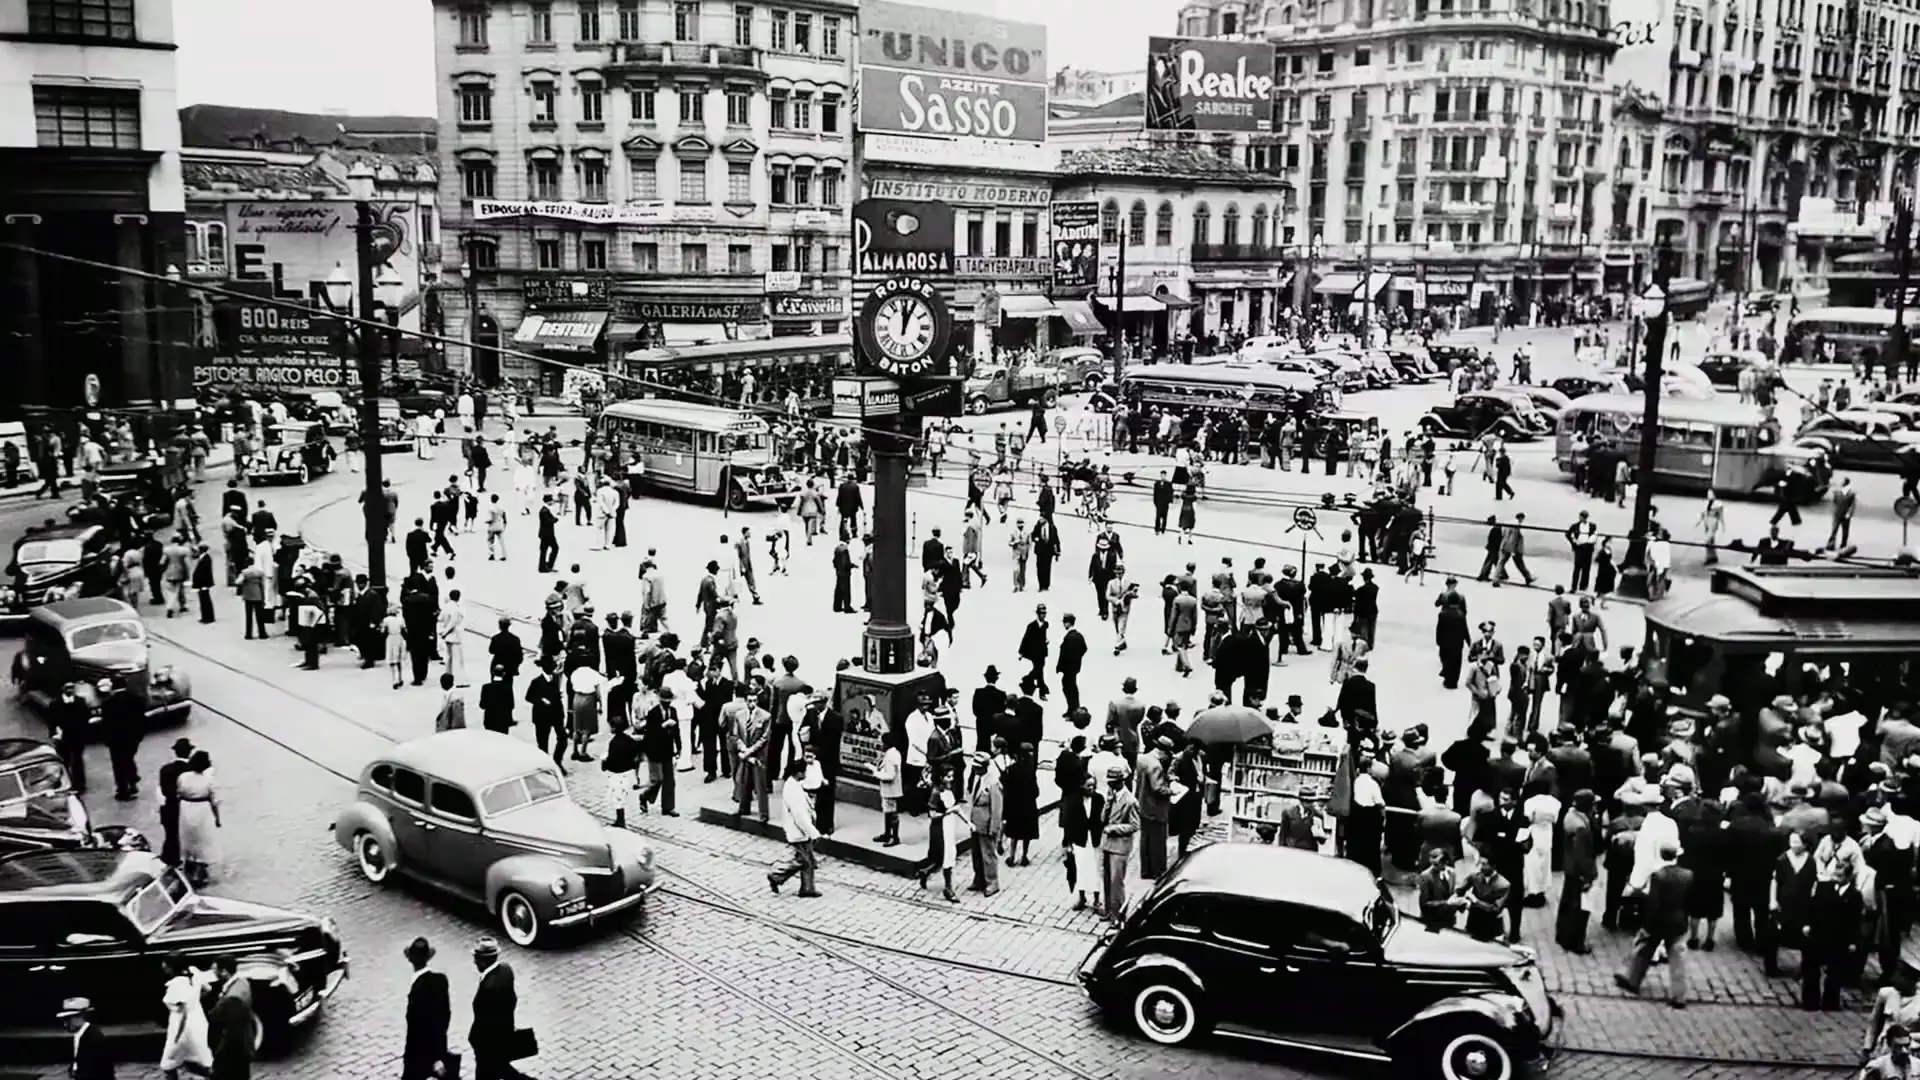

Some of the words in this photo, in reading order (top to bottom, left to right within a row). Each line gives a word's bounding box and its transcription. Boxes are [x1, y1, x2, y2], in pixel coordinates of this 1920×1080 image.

[1180, 49, 1273, 100] Realce
[940, 78, 1000, 95] AZEITE
[900, 75, 1016, 137] Sasso
[1195, 101, 1254, 116] SABONETE
[874, 180, 967, 200] INSTITUTO
[973, 186, 1049, 203] MODERNO
[855, 217, 949, 277] PALMAROSA
[966, 259, 1035, 274] TACHYGRAPHIA
[875, 278, 934, 298] ROUGE
[240, 307, 278, 329] 800
[641, 304, 705, 318] GALERIA
[879, 355, 934, 375] BATON
